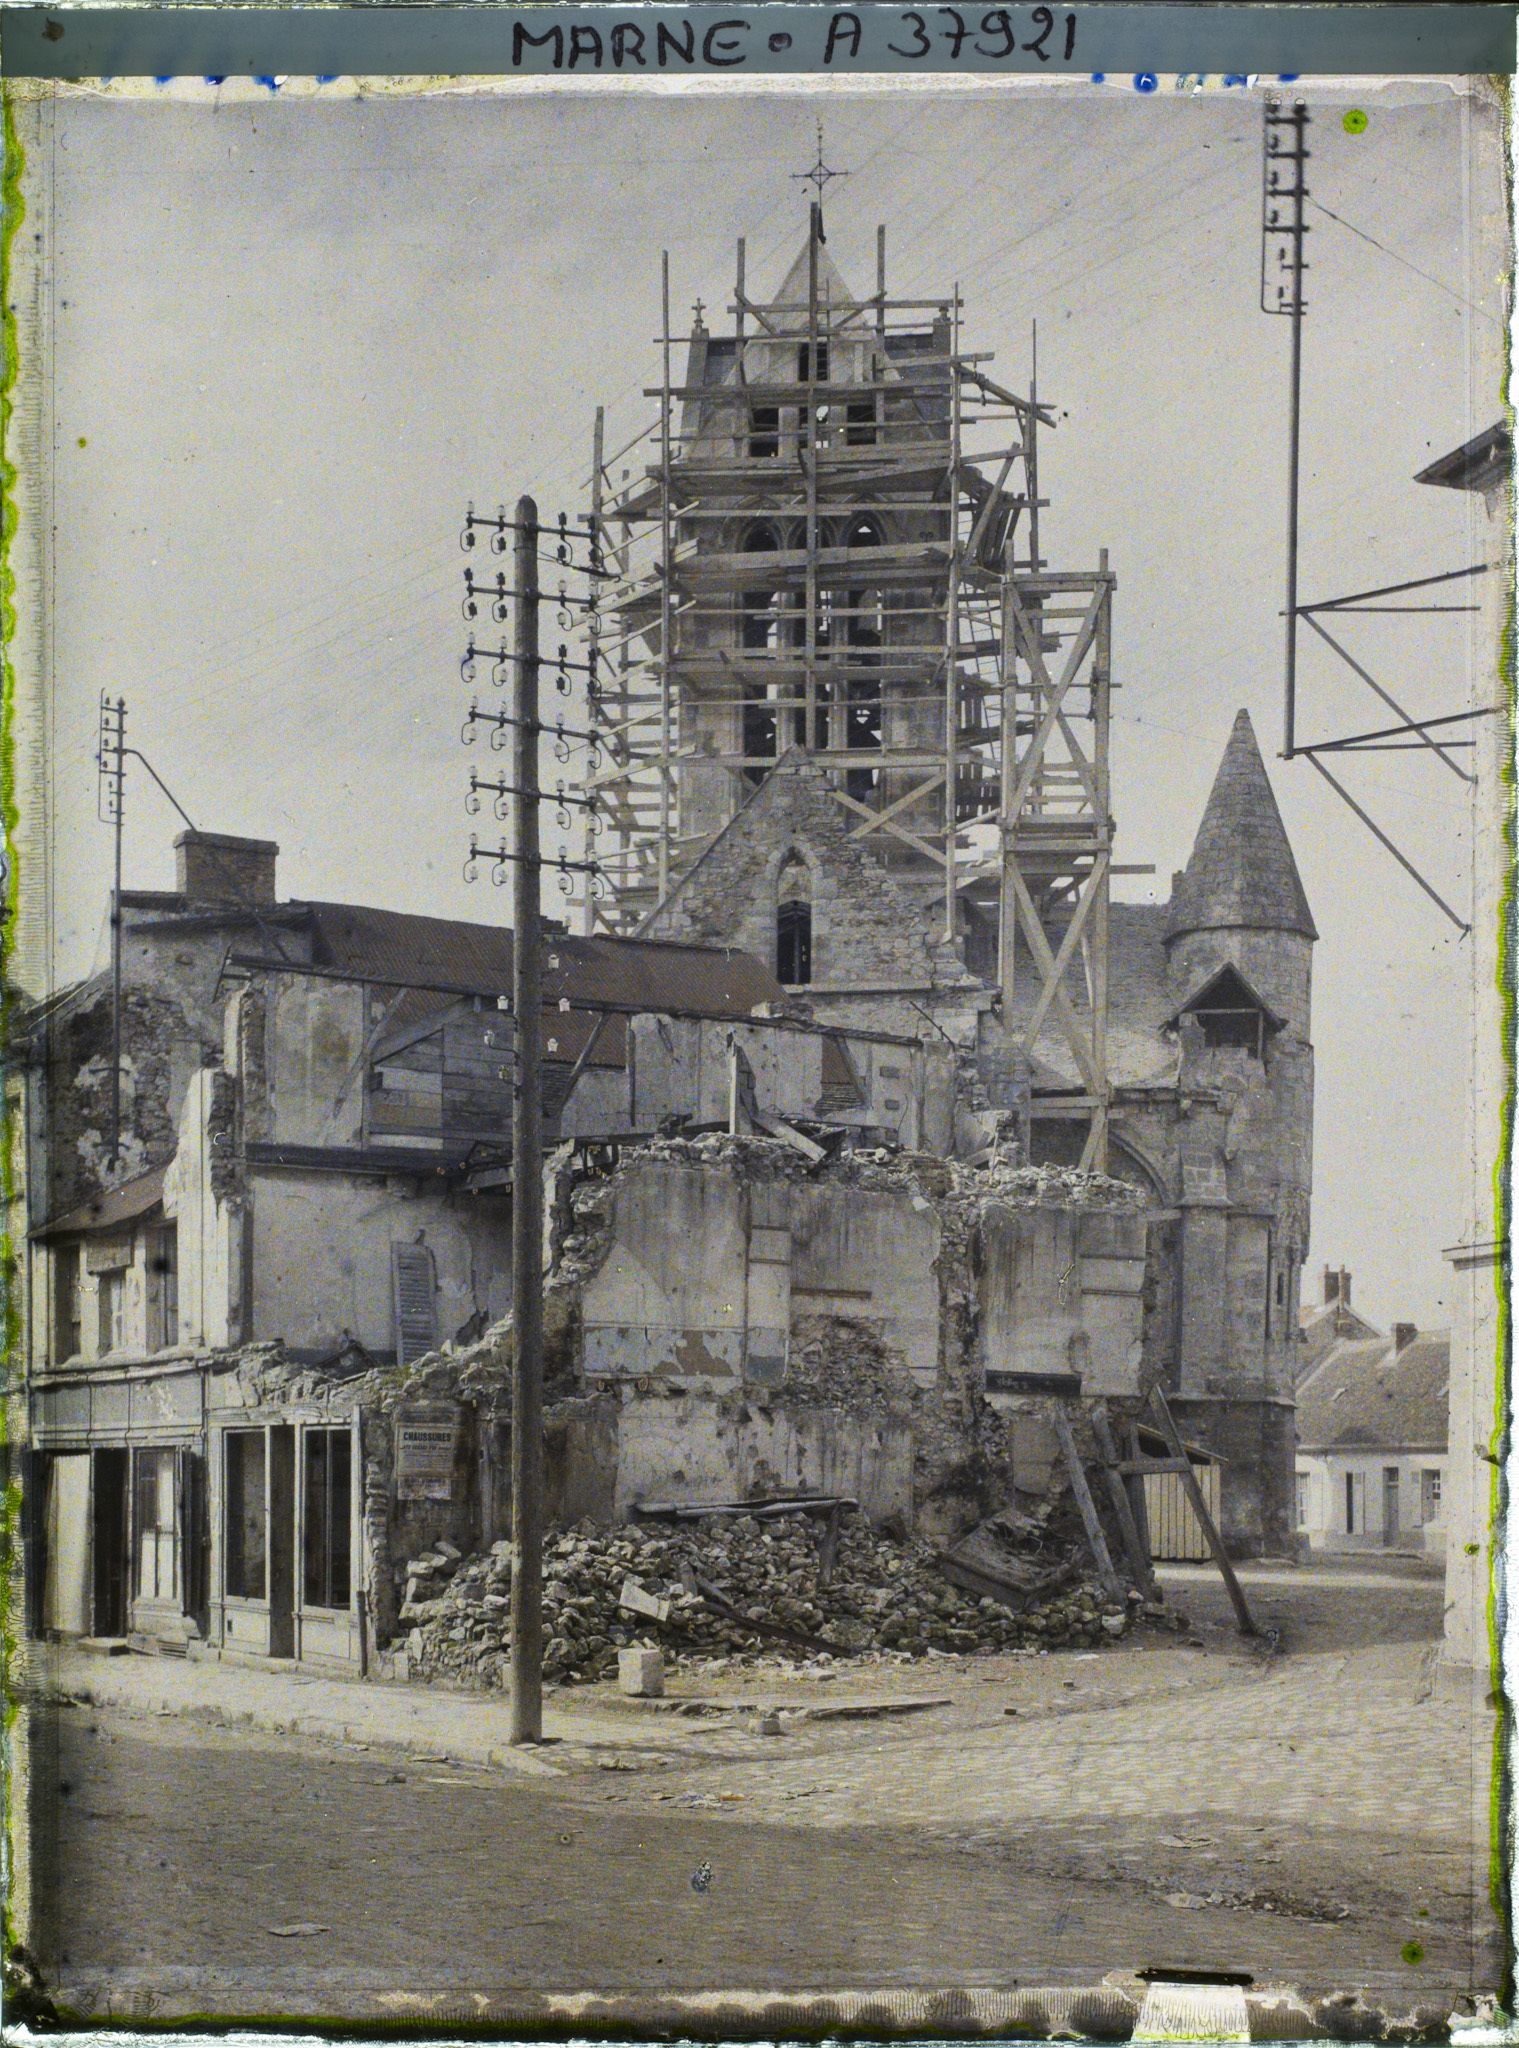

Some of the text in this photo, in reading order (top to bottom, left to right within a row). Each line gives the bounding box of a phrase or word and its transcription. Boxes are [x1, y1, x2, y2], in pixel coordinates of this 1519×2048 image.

[824, 12, 862, 65] A
[887, 7, 1077, 62] 37921
[403, 1431, 451, 1441] CHAUSSURES
